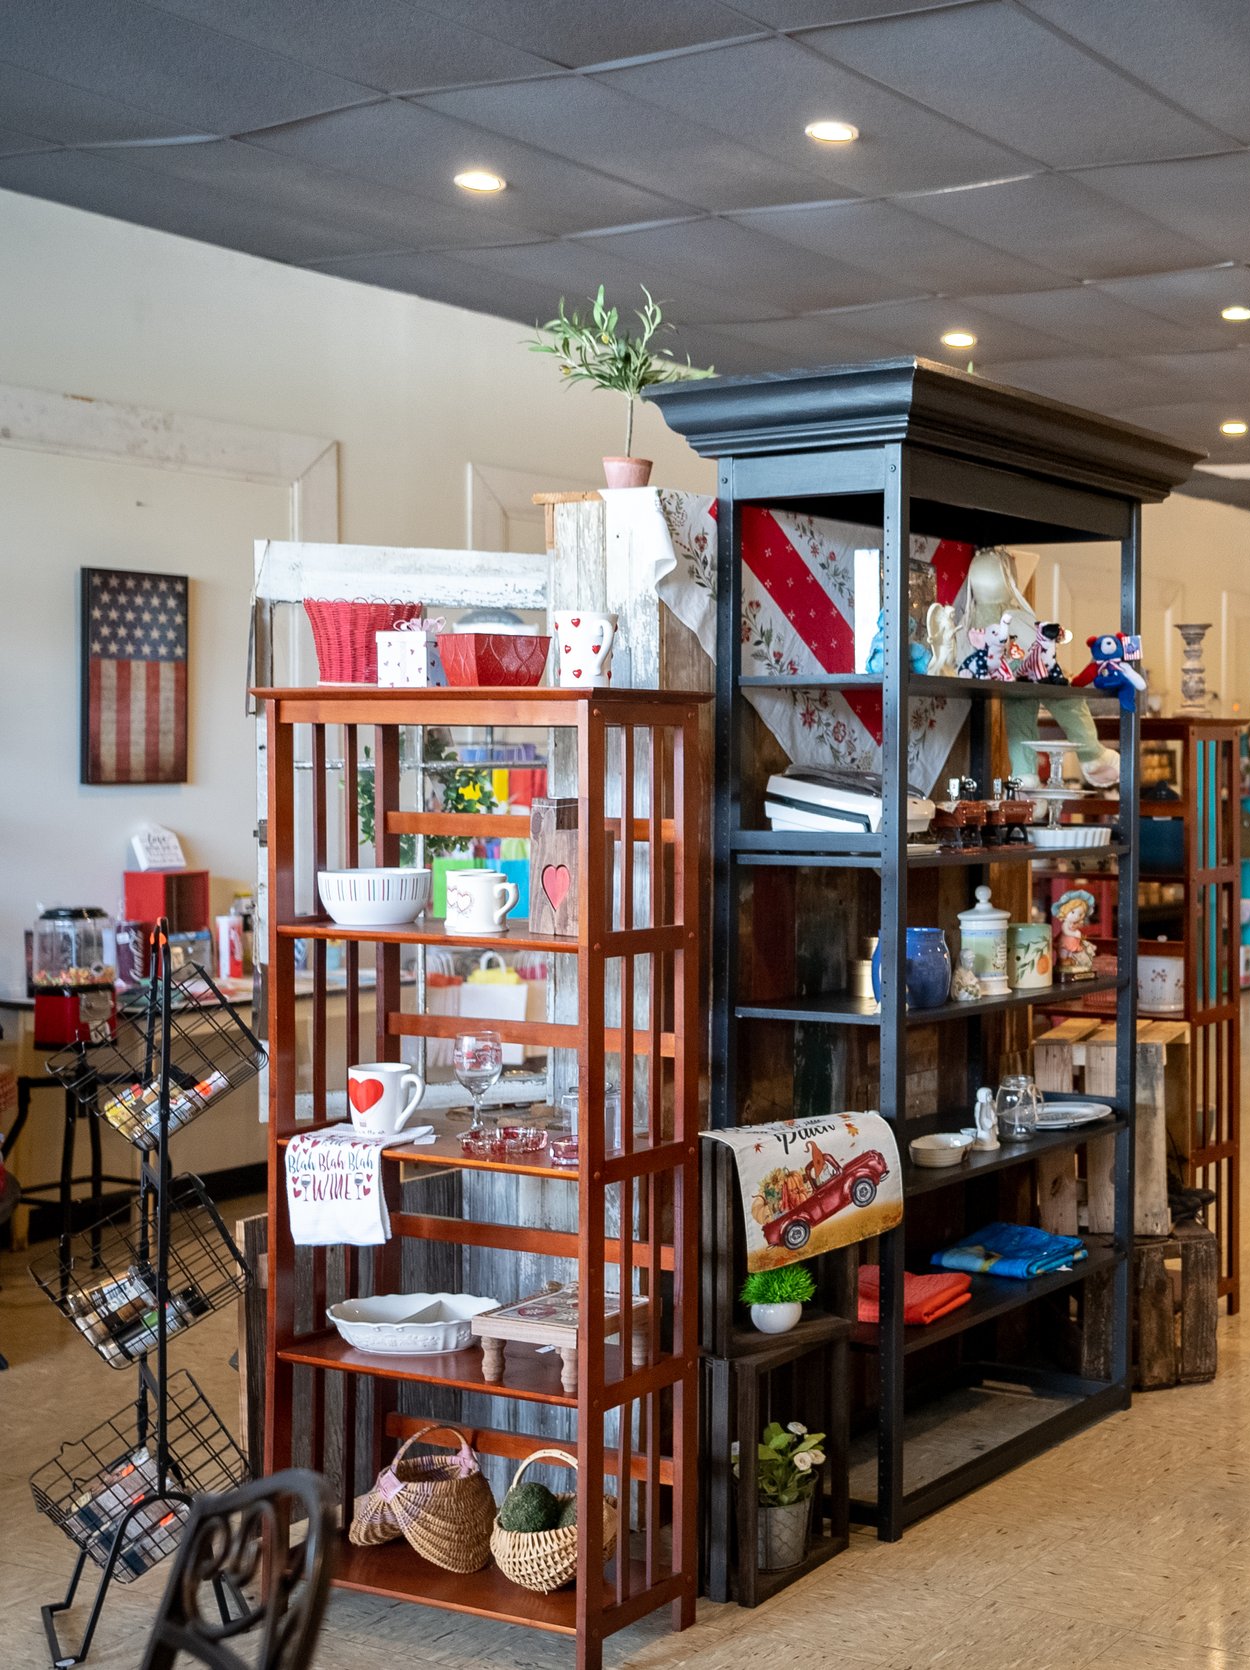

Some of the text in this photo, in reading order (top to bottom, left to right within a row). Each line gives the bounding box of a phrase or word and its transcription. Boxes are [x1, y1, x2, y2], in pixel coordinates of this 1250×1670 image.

[288, 1149, 374, 1173] Blah Blah Blah
[312, 1172, 353, 1201] WINE
